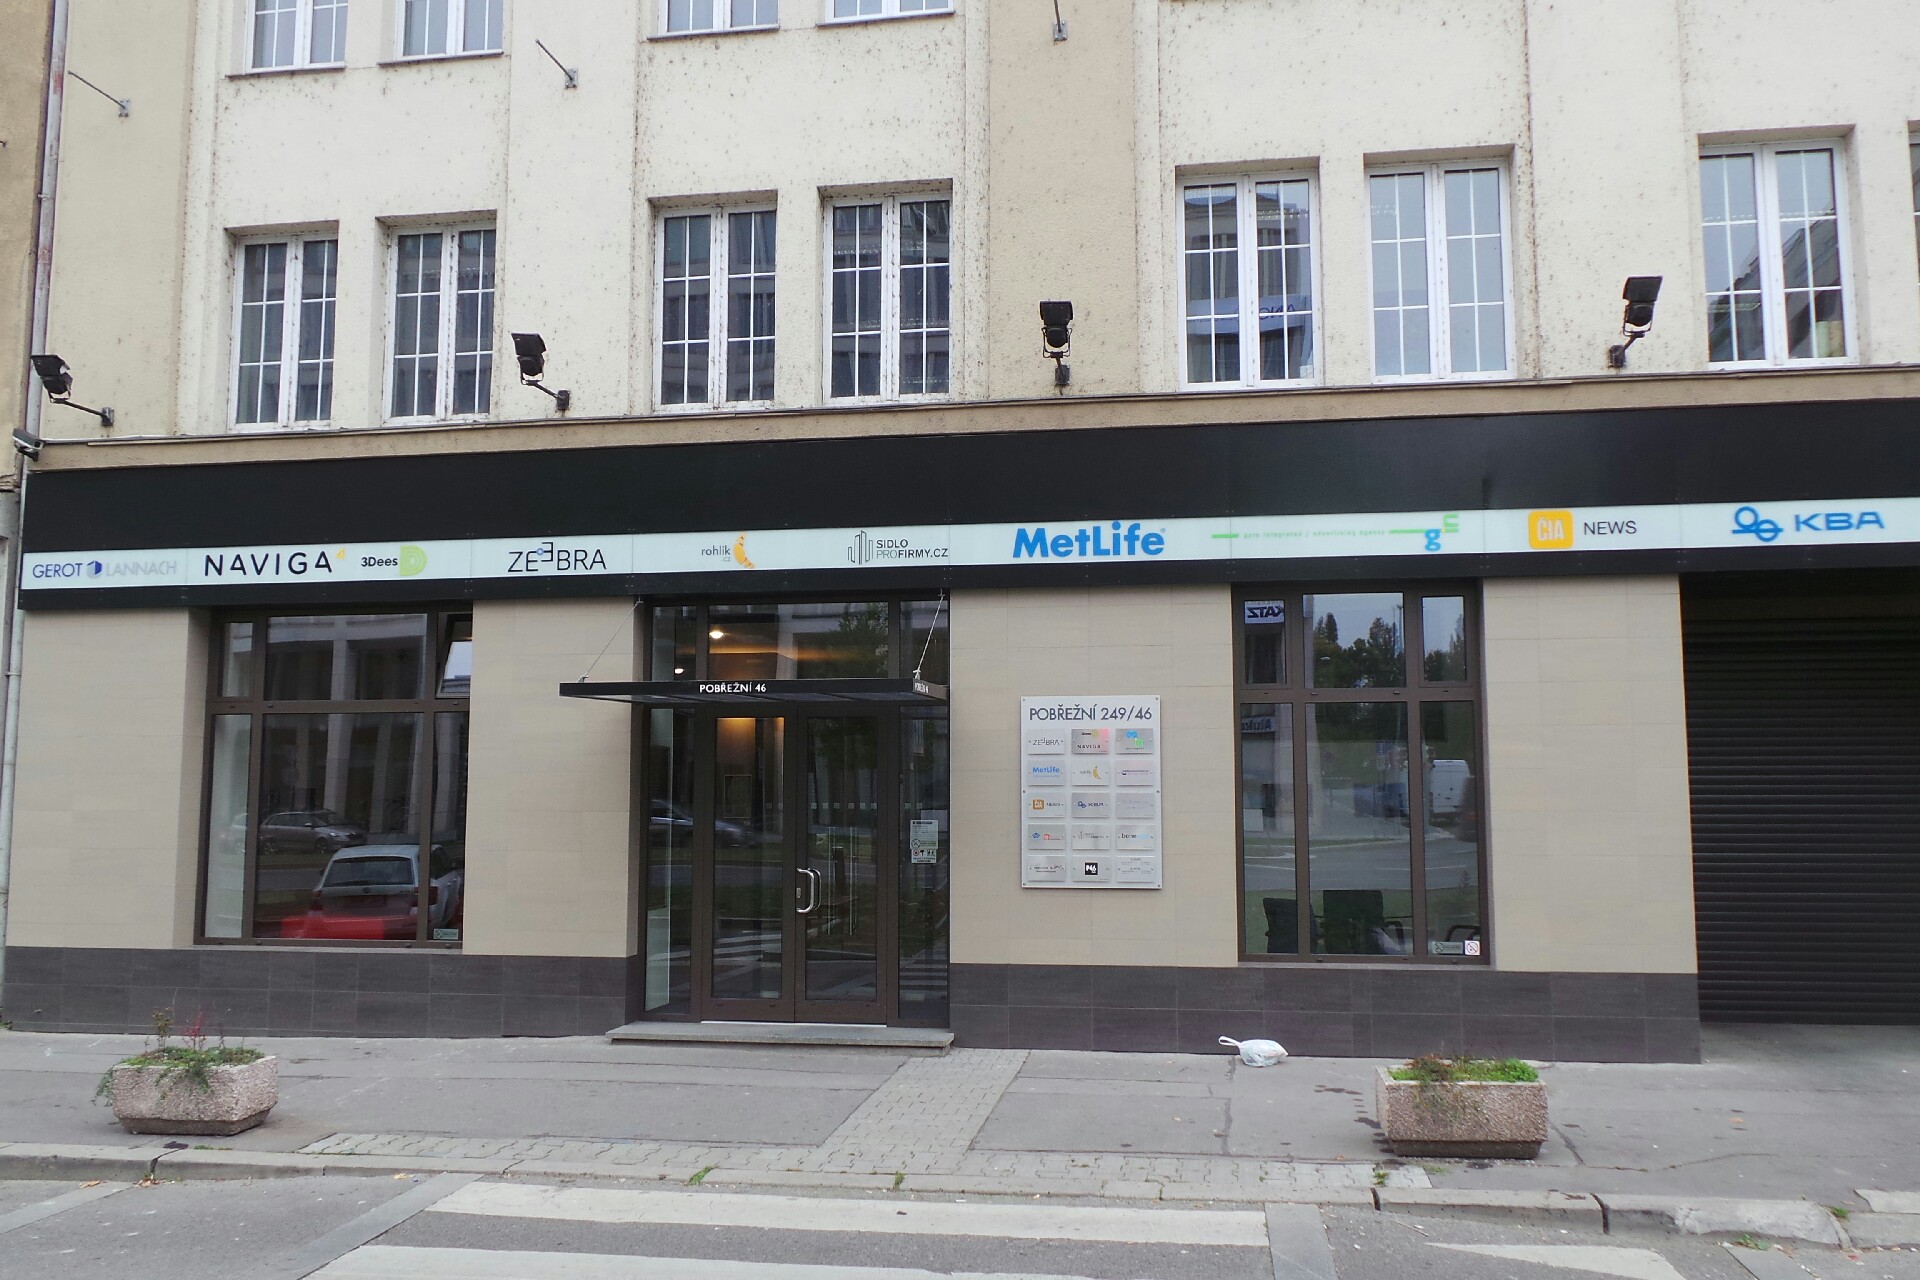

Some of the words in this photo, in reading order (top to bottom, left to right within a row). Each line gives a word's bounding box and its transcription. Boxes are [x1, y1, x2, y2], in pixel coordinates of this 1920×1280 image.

[1583, 520, 1637, 535] NEWS
[1795, 511, 1885, 532] KBA
[876, 538, 909, 549] SIDLO
[701, 546, 731, 556] rohlik
[876, 548, 949, 559] PROFIRMY.CZ
[204, 550, 333, 577] NAVIGA
[360, 556, 399, 568] 3Dees
[32, 562, 83, 579] GEROT
[105, 560, 177, 577] LANNACH
[699, 681, 753, 694] POBŘEŽNÍ
[754, 682, 767, 693] 46
[1029, 703, 1098, 721] POBŘEŽNÍ
[1100, 705, 1153, 722] 249/46
